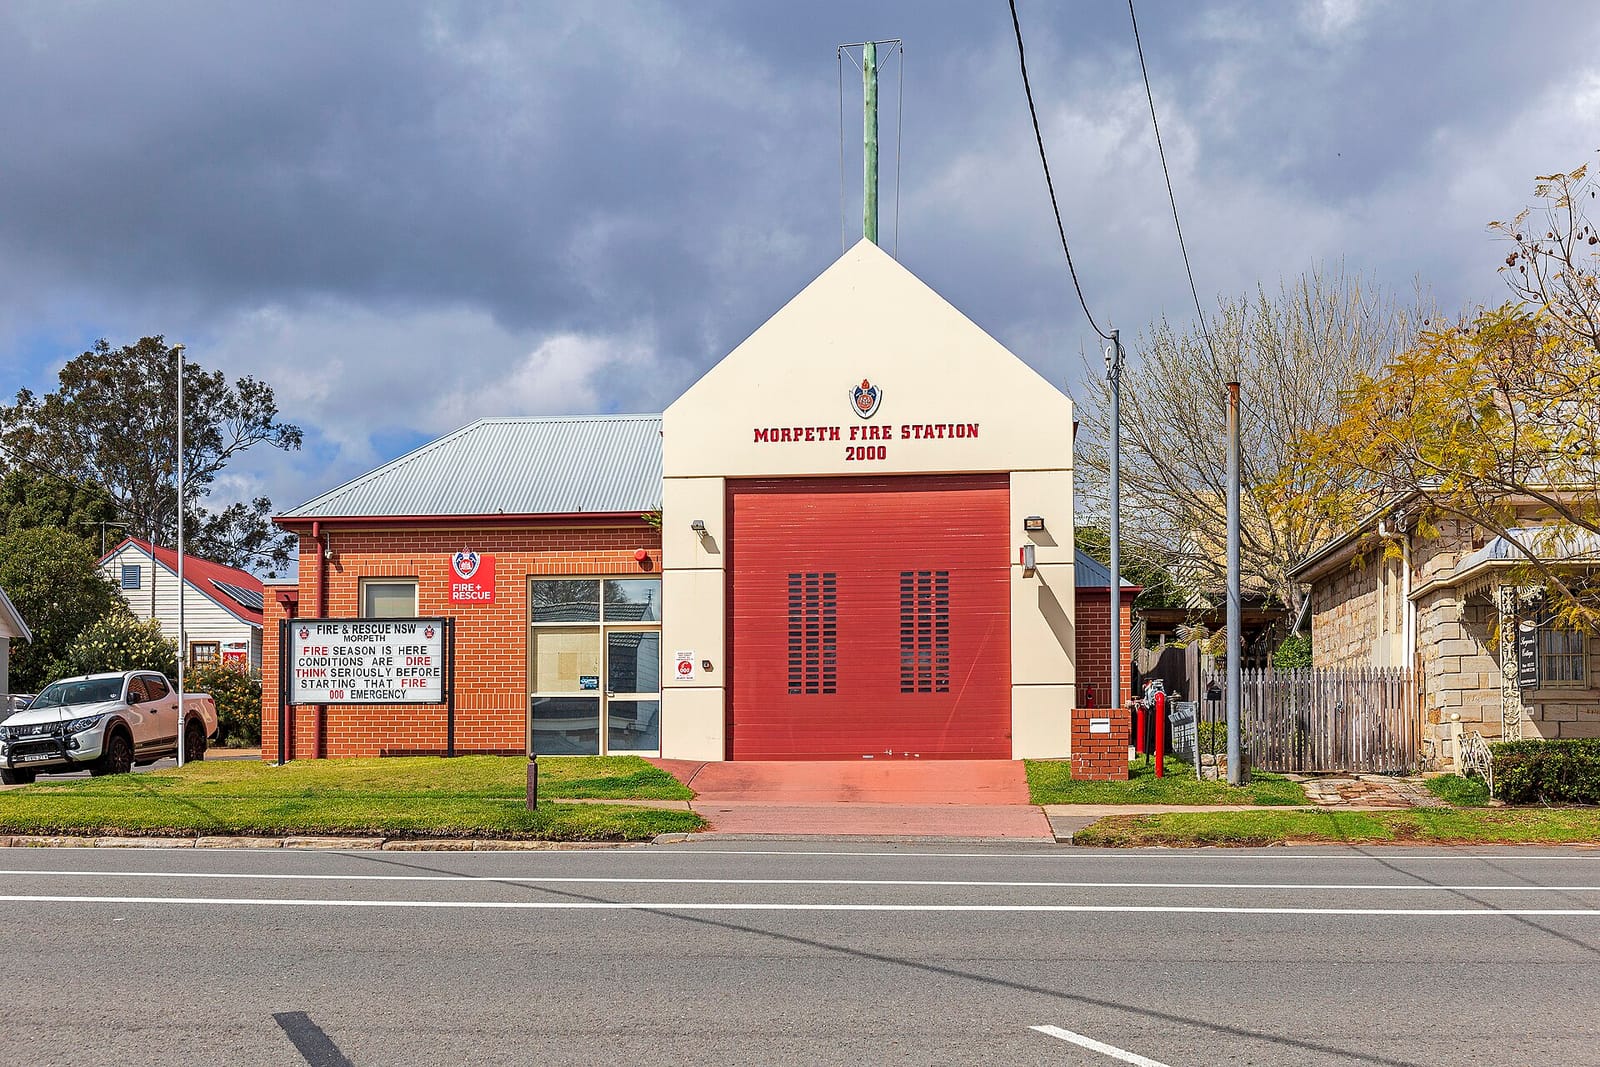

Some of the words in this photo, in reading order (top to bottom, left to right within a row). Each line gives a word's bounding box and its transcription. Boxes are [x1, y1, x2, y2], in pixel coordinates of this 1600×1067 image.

[753, 426, 841, 443] MORPETH
[849, 425, 892, 440] FIRE
[901, 423, 979, 439] STATION
[846, 446, 887, 461] 2000
[317, 625, 339, 634] FIRE
[342, 625, 349, 634] &
[352, 624, 391, 634] RESCUE
[394, 624, 416, 634] NSW
[303, 647, 328, 655] FIRE
[333, 647, 376, 655] SEASON
[382, 646, 391, 655] IS
[398, 646, 427, 655] HERE
[298, 657, 363, 666] CONDITIONS
[372, 657, 393, 666] ARE
[406, 657, 431, 665] DIRE
[296, 669, 326, 677] THINK
[331, 668, 391, 677] SERIOUSLY
[396, 668, 440, 676] BEFORE
[301, 680, 355, 688] STARTING
[364, 679, 393, 688] THAT
[402, 679, 426, 687] FIRE
[351, 690, 406, 699] EMERGENCY
